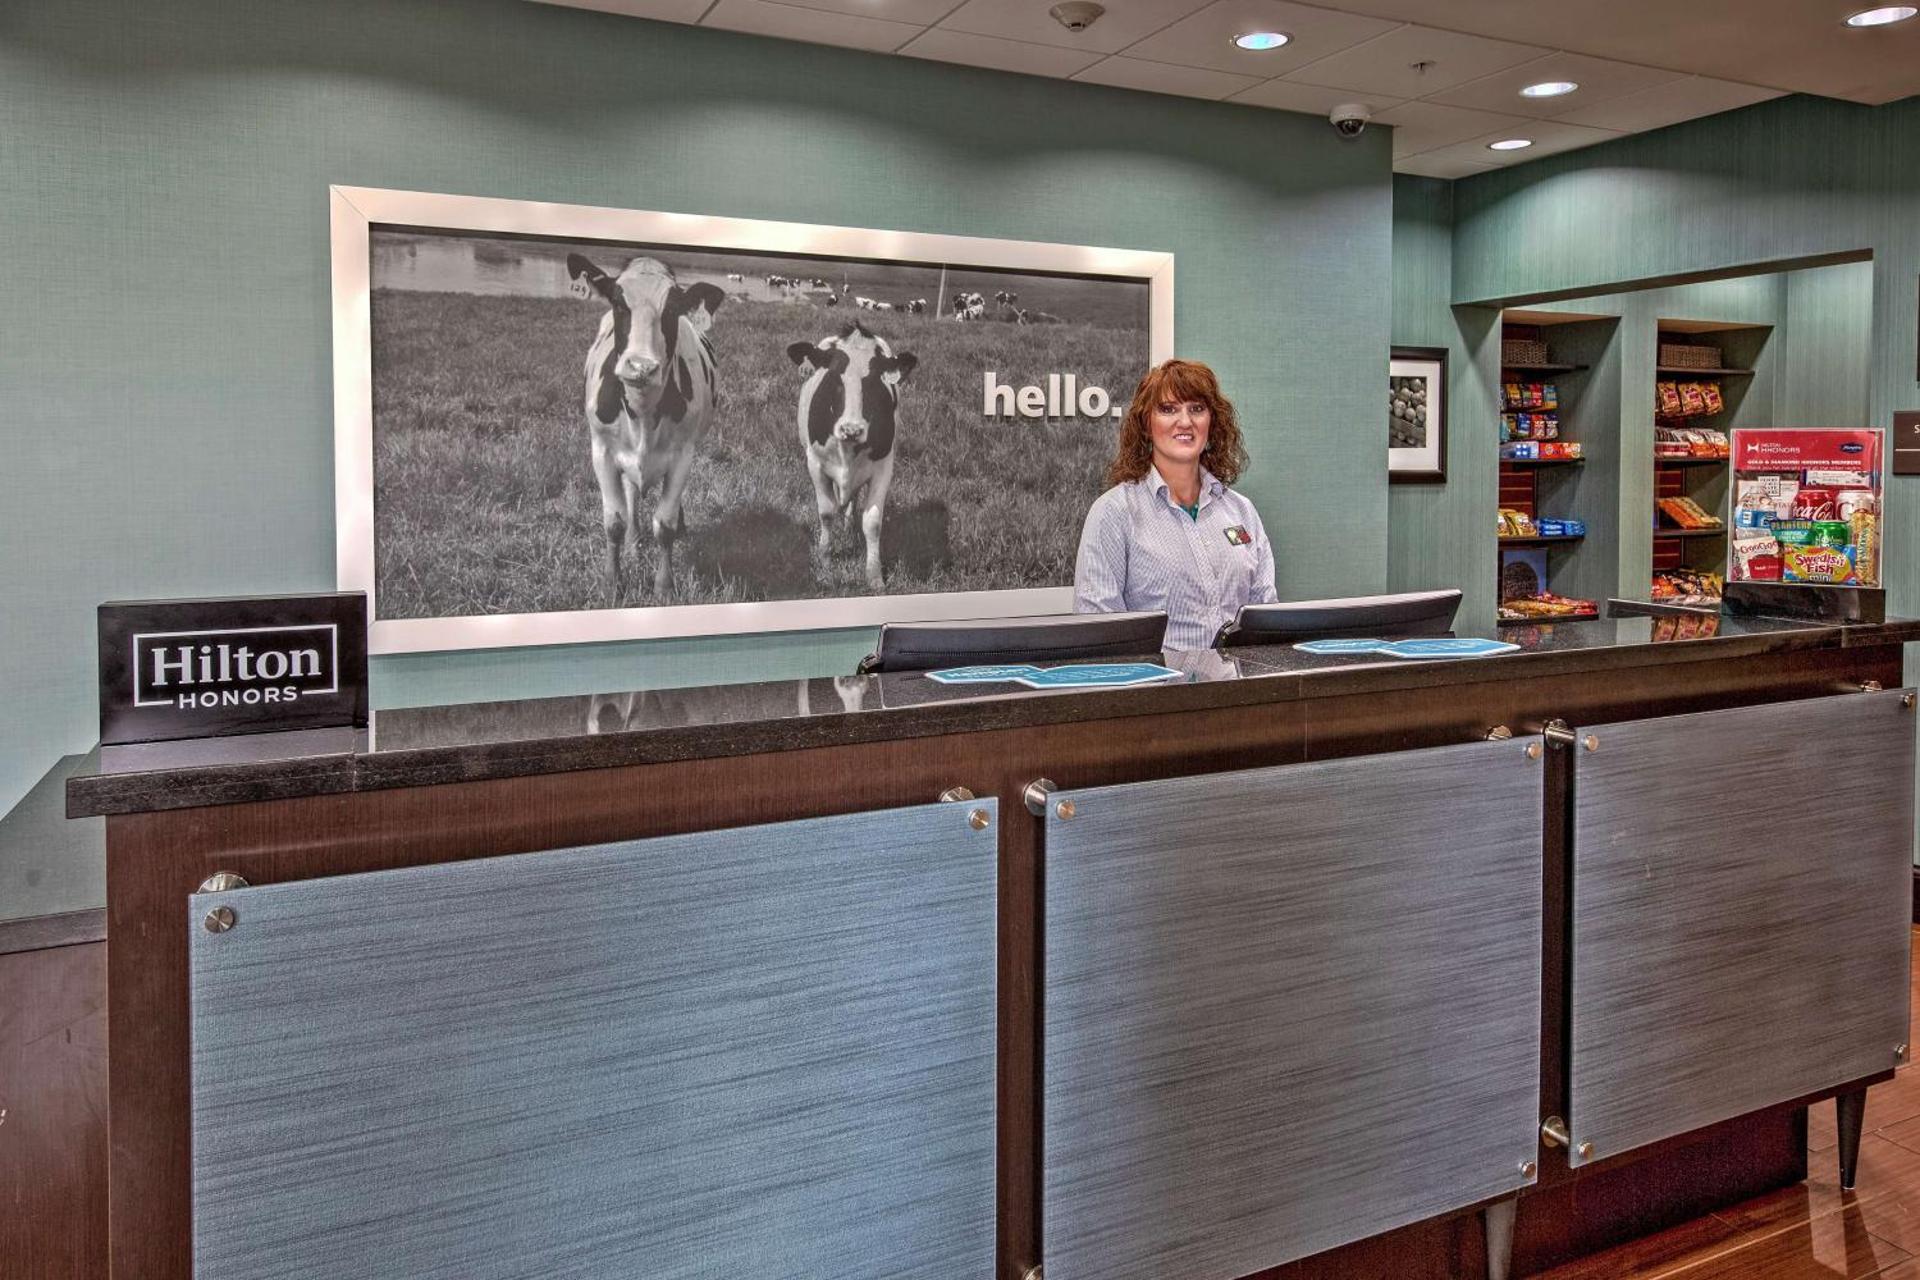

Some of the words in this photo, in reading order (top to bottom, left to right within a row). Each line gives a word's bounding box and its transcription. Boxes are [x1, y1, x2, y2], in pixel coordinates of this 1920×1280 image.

[983, 371, 1122, 418] hello.
[1793, 552, 1846, 568] Swedish
[1807, 564, 1834, 576] Fish
[151, 644, 322, 686] Hilton
[178, 685, 298, 710] HONORS
